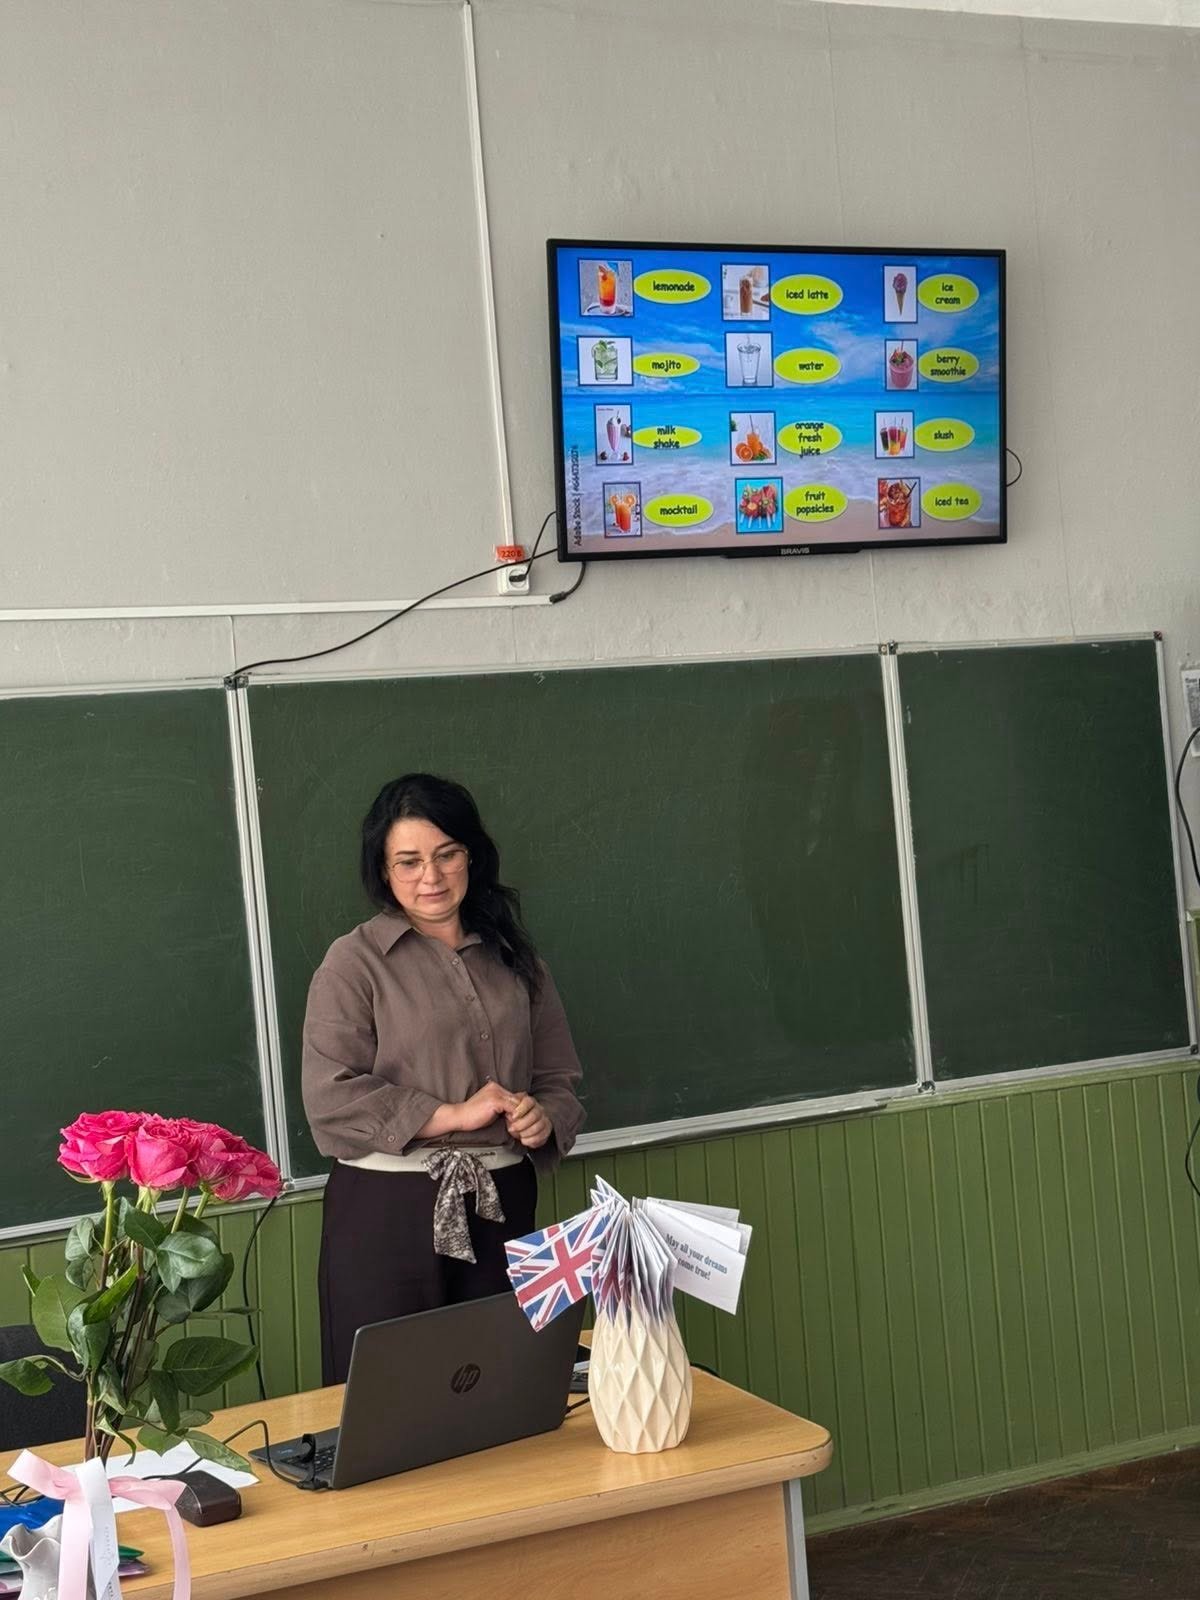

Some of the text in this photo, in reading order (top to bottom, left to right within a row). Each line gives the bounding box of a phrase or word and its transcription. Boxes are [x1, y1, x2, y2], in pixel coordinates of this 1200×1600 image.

[652, 281, 695, 292] lemonade
[941, 282, 953, 292] ice
[786, 289, 829, 300] iced latte
[935, 295, 961, 305] cream
[651, 359, 681, 372] mojito
[936, 354, 960, 366] berry
[798, 361, 824, 371] water
[930, 367, 966, 376] smoothie
[656, 425, 676, 435] milk
[795, 421, 824, 432] orange
[798, 433, 822, 443] fresh
[933, 430, 954, 440] slush
[653, 439, 680, 449] shake
[799, 445, 821, 458] juice
[804, 491, 825, 502] fruit
[935, 496, 969, 506] iced tea
[573, 497, 581, 519] Stock
[659, 504, 698, 515] mocktail
[796, 504, 834, 515] popsicles
[574, 520, 582, 546] Adobe
[781, 547, 810, 555] BRAVIS
[665, 1233, 727, 1274] May all your dreams
[695, 1265, 711, 1280] true!
[451, 1363, 481, 1395] hp
